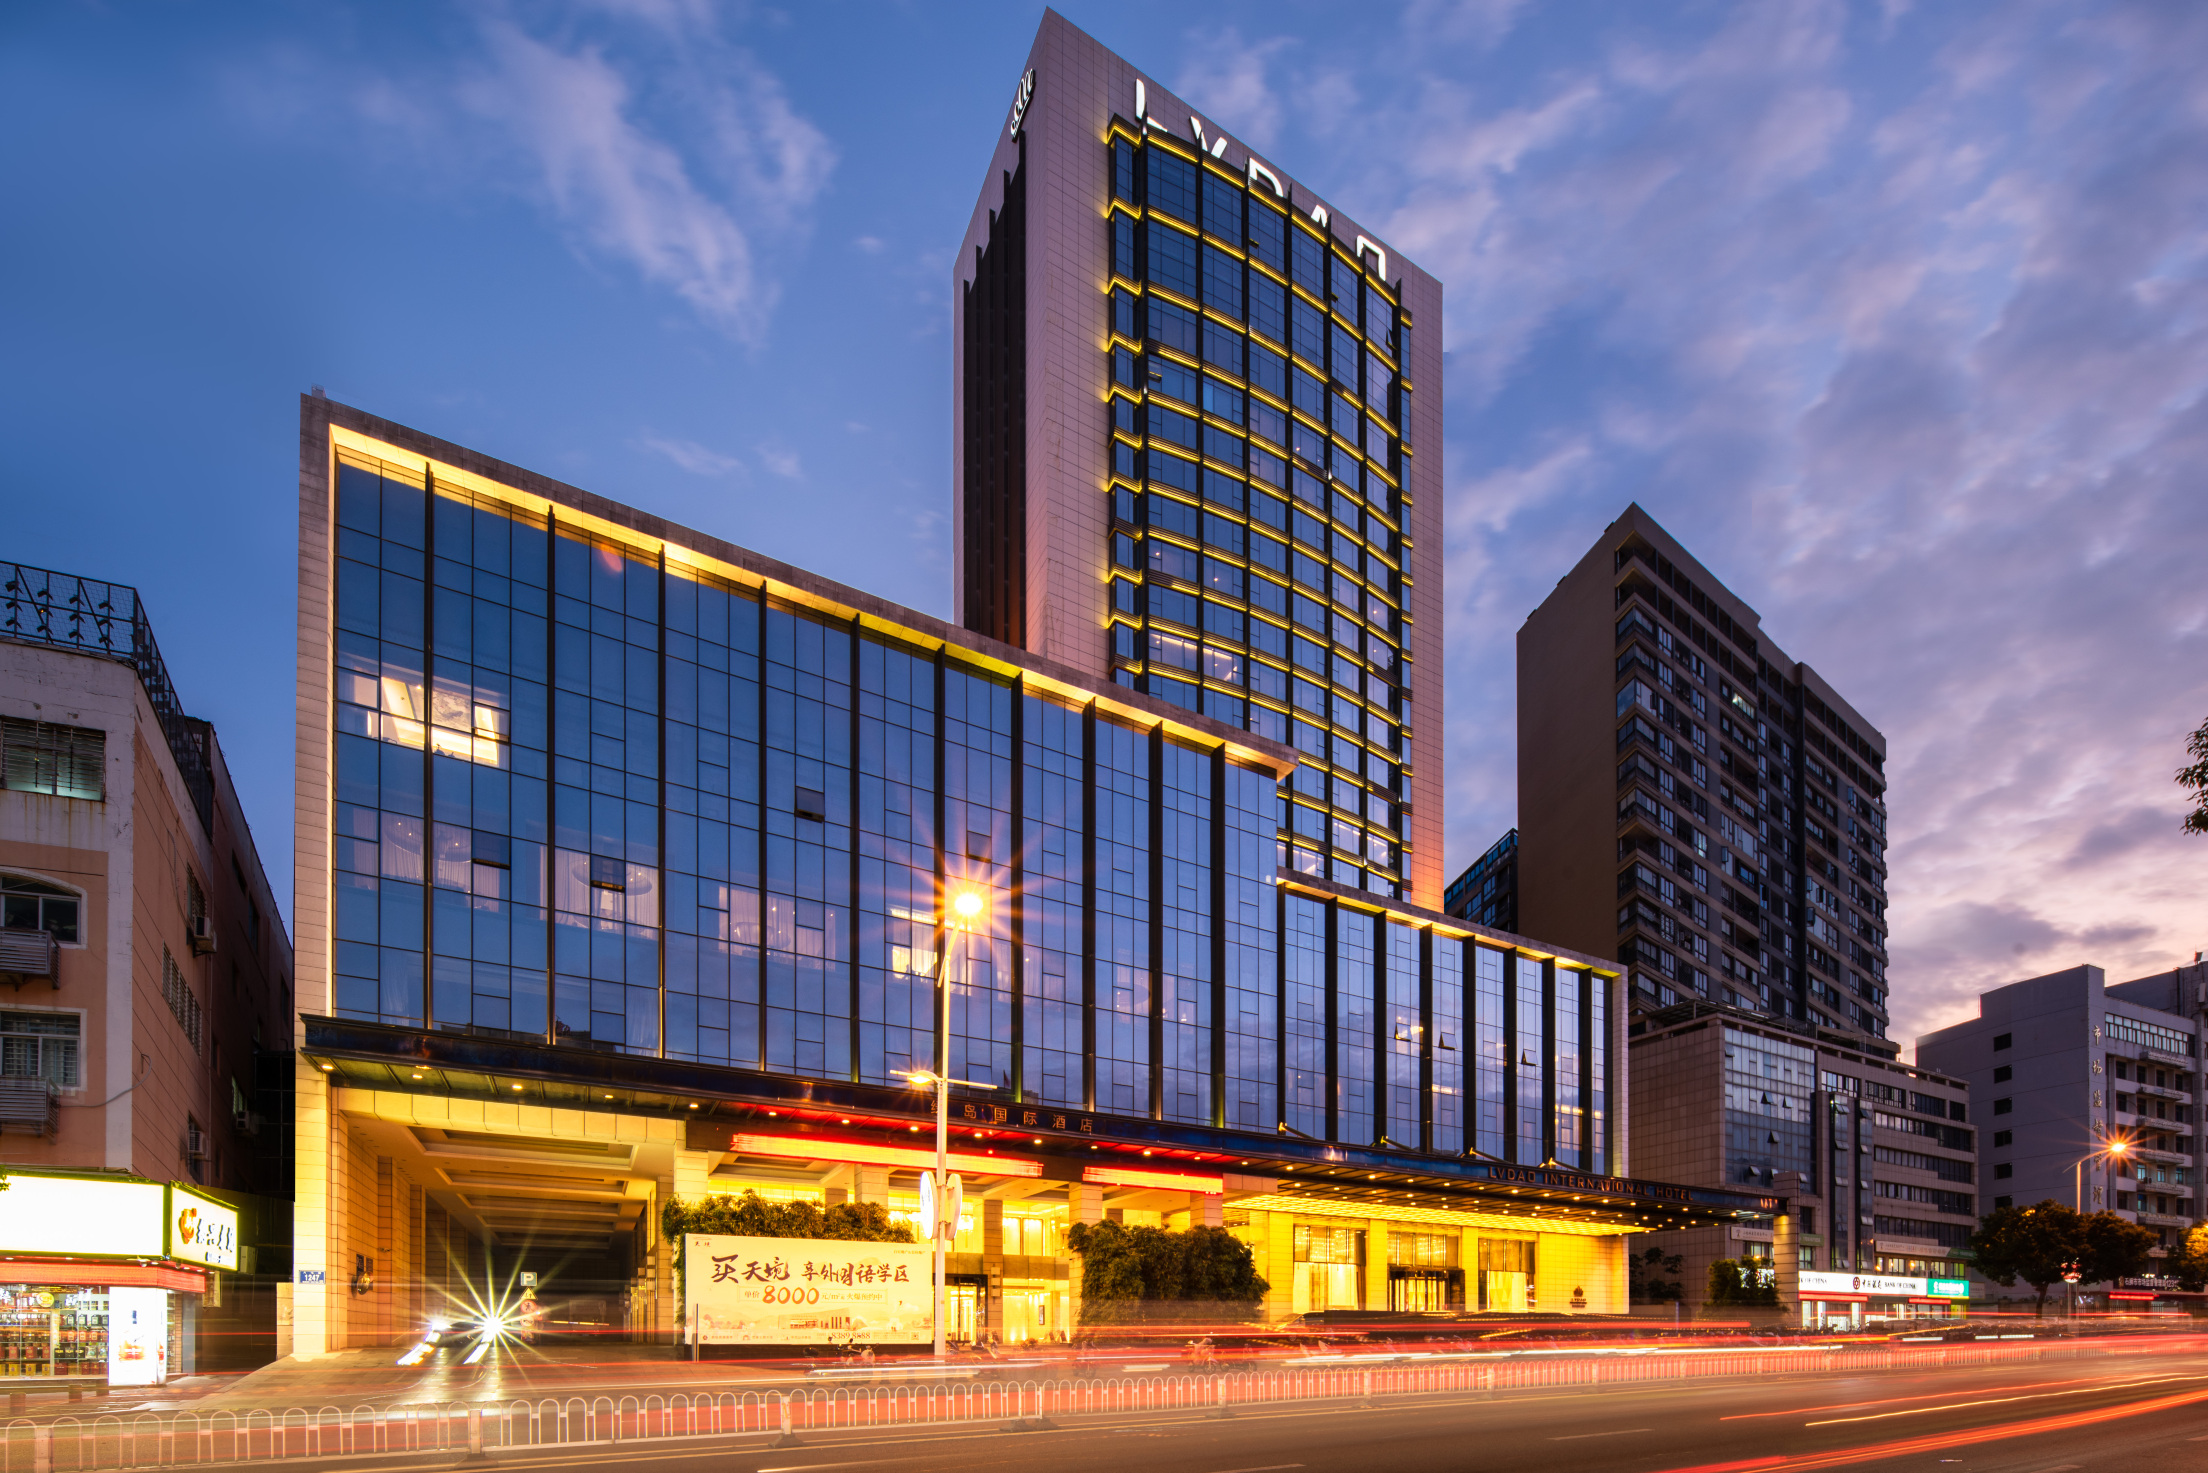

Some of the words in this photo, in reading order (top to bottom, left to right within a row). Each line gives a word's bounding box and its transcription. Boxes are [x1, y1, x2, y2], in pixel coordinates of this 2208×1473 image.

[1489, 1166, 1536, 1183] LVDAO
[1544, 1173, 1650, 1196] INTERNATIONAL
[1656, 1186, 1694, 1201] HOTEL
[711, 1254, 790, 1283] 买天境
[801, 1260, 910, 1287] 享外国语学区
[523, 1273, 534, 1285] P
[1862, 1279, 1882, 1290] 中国银行
[744, 1290, 760, 1299] 单价
[762, 1285, 820, 1305] 8000
[832, 1332, 850, 1340] 8389
